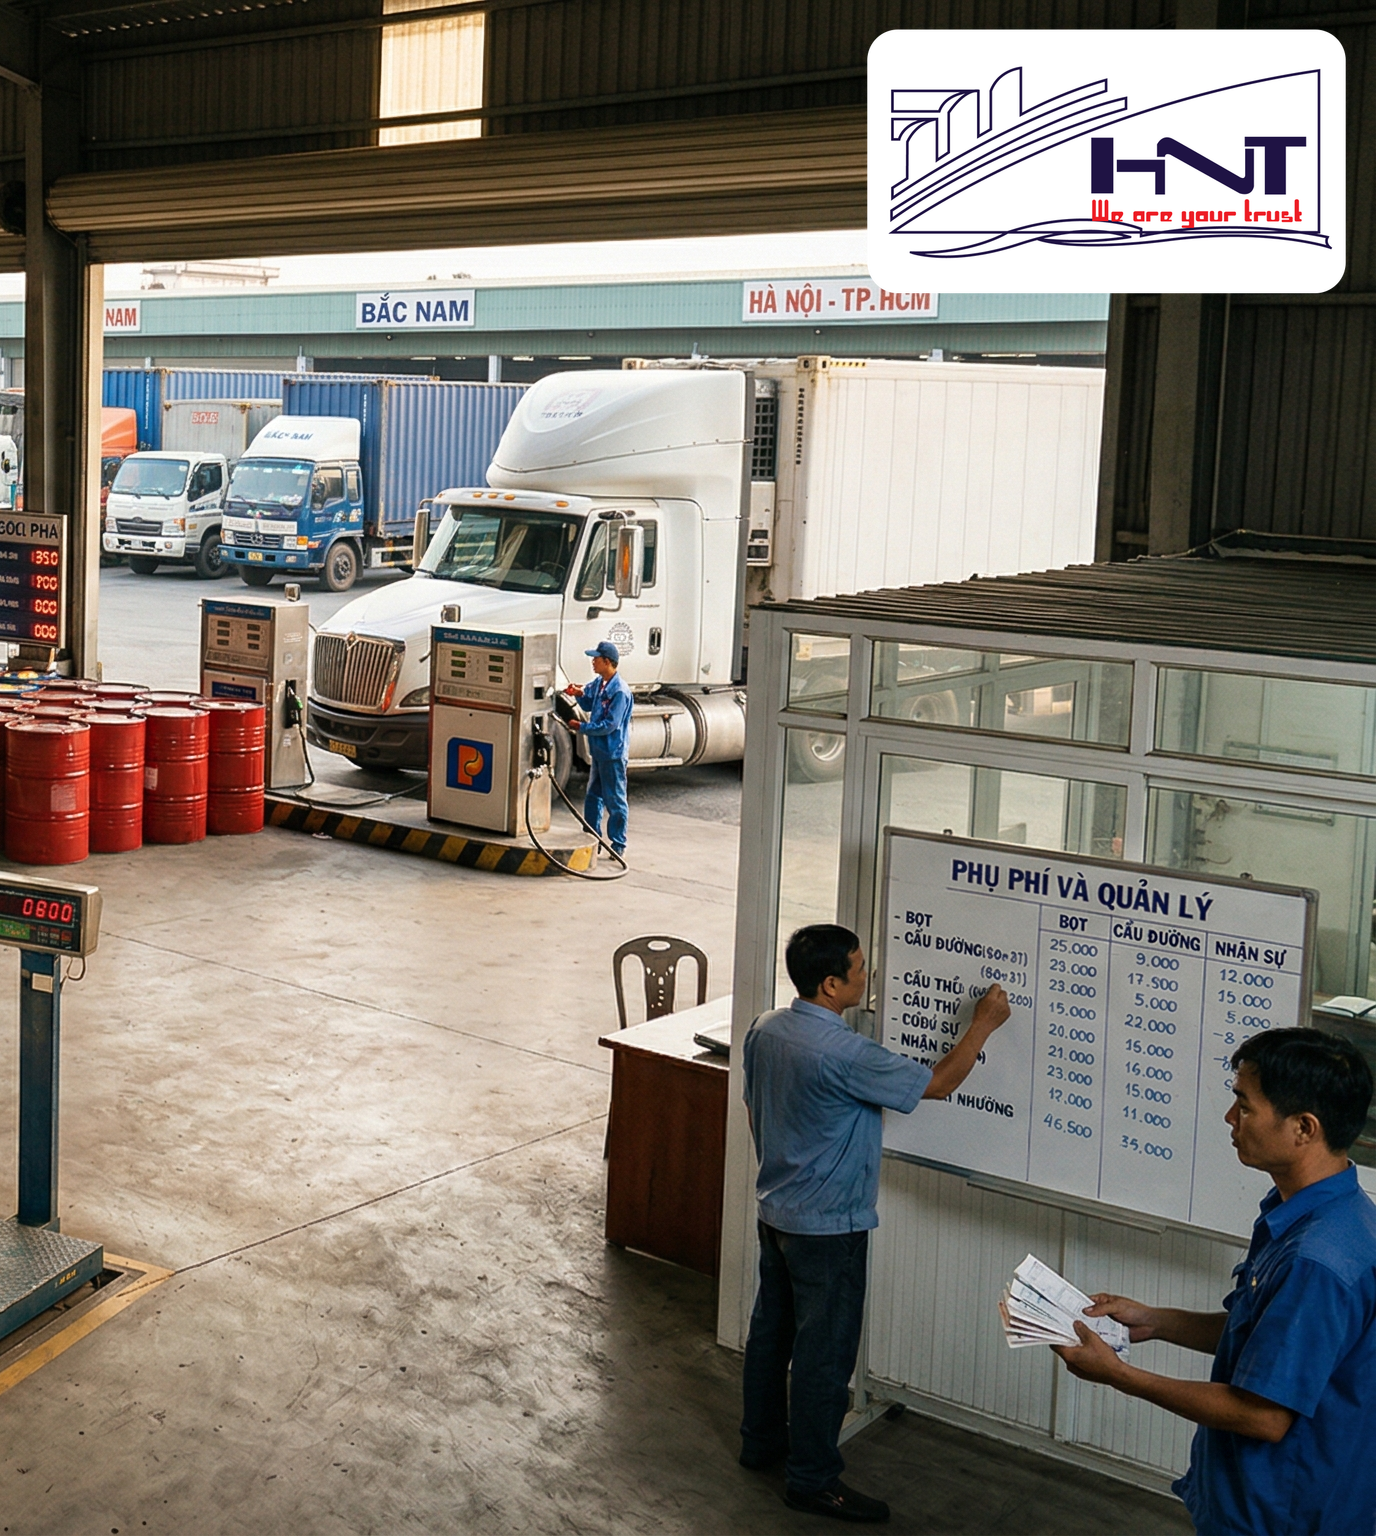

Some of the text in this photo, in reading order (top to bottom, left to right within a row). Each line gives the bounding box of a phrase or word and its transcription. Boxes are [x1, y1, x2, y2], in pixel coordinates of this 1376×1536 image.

[361, 292, 469, 323] BẮC NAM
[749, 284, 777, 314] HÀ
[785, 283, 822, 318] NỘI
[841, 287, 931, 312] TP.HCM
[105, 308, 137, 327] NAM
[30, 523, 59, 539] PHA
[952, 859, 1214, 922] PHỤ PHÍ VÀ QUẢN LÝ
[905, 911, 933, 928] BỌT
[1050, 938, 1098, 958] 25.000
[1059, 914, 1088, 932] BỌT
[1215, 941, 1259, 963] NHẬN
[1263, 949, 1288, 969] SỰ
[1049, 958, 1097, 978] 23.000
[1136, 952, 1180, 971] 9.000
[1049, 978, 1097, 998] 23.000
[1219, 969, 1274, 989] 12.000
[1134, 993, 1178, 1013] 5.000
[1218, 989, 1272, 1010] 15.000
[1049, 1001, 1097, 1021] 15.000
[1224, 1010, 1271, 1029] 5.000
[1048, 1023, 1095, 1044] 20.000
[1124, 1013, 1177, 1035] 22.000
[1048, 1045, 1095, 1065] 21.000
[1047, 1065, 1093, 1086] 23.000
[1125, 1082, 1172, 1105] 15.000
[1122, 1105, 1172, 1129] 11.000
